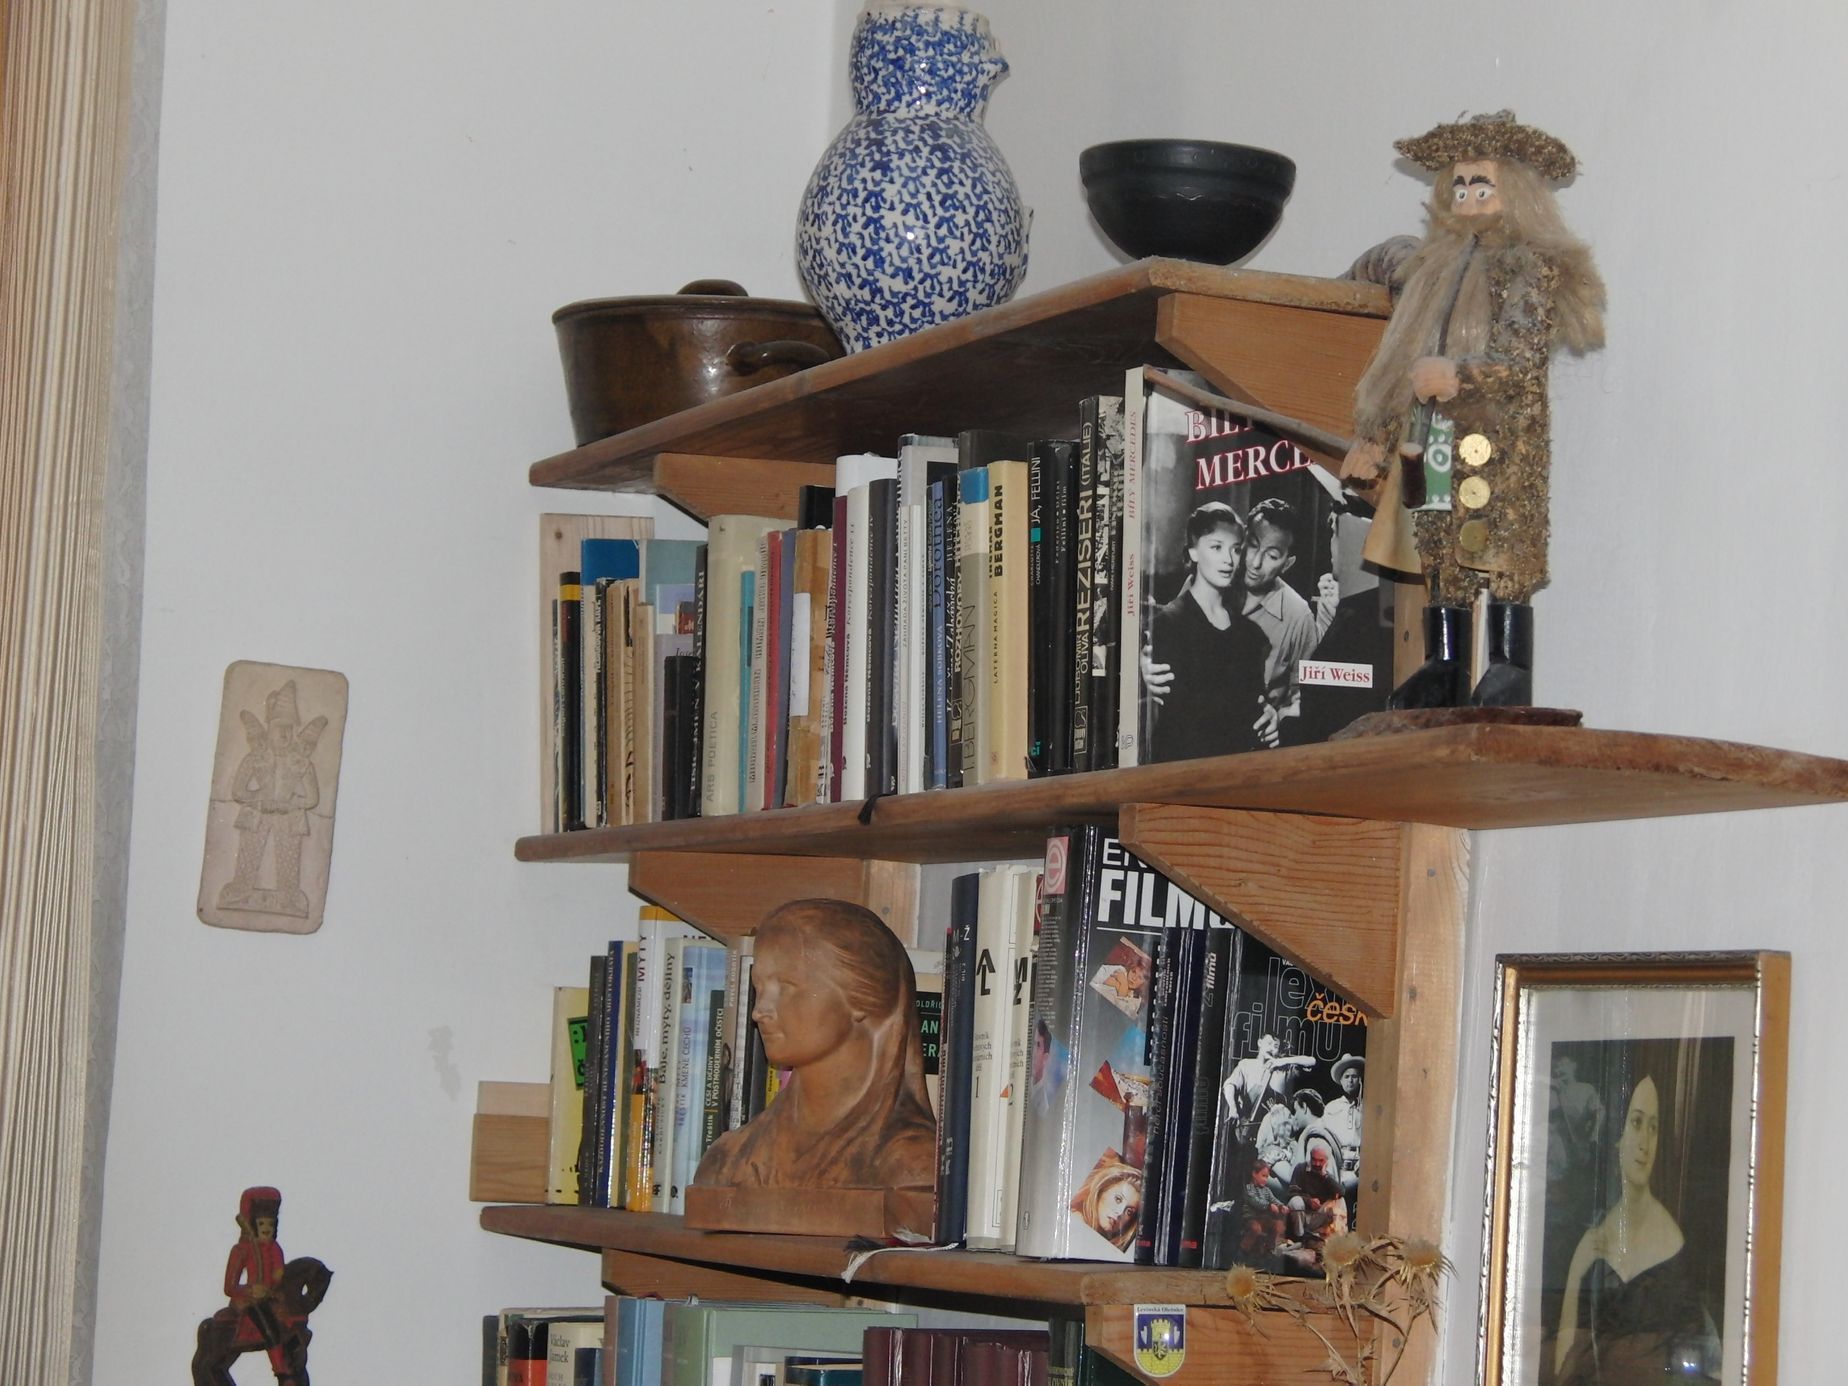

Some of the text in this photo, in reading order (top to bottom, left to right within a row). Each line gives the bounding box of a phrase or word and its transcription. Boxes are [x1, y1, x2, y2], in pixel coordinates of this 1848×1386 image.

[1031, 457, 1041, 500] FELLINI
[994, 484, 1003, 577] BERGMAN
[932, 497, 943, 608] Dorothea
[1127, 553, 1136, 591] Weiss
[1080, 632, 1089, 674] OLIVA
[1300, 663, 1371, 684] Jiří Weiss
